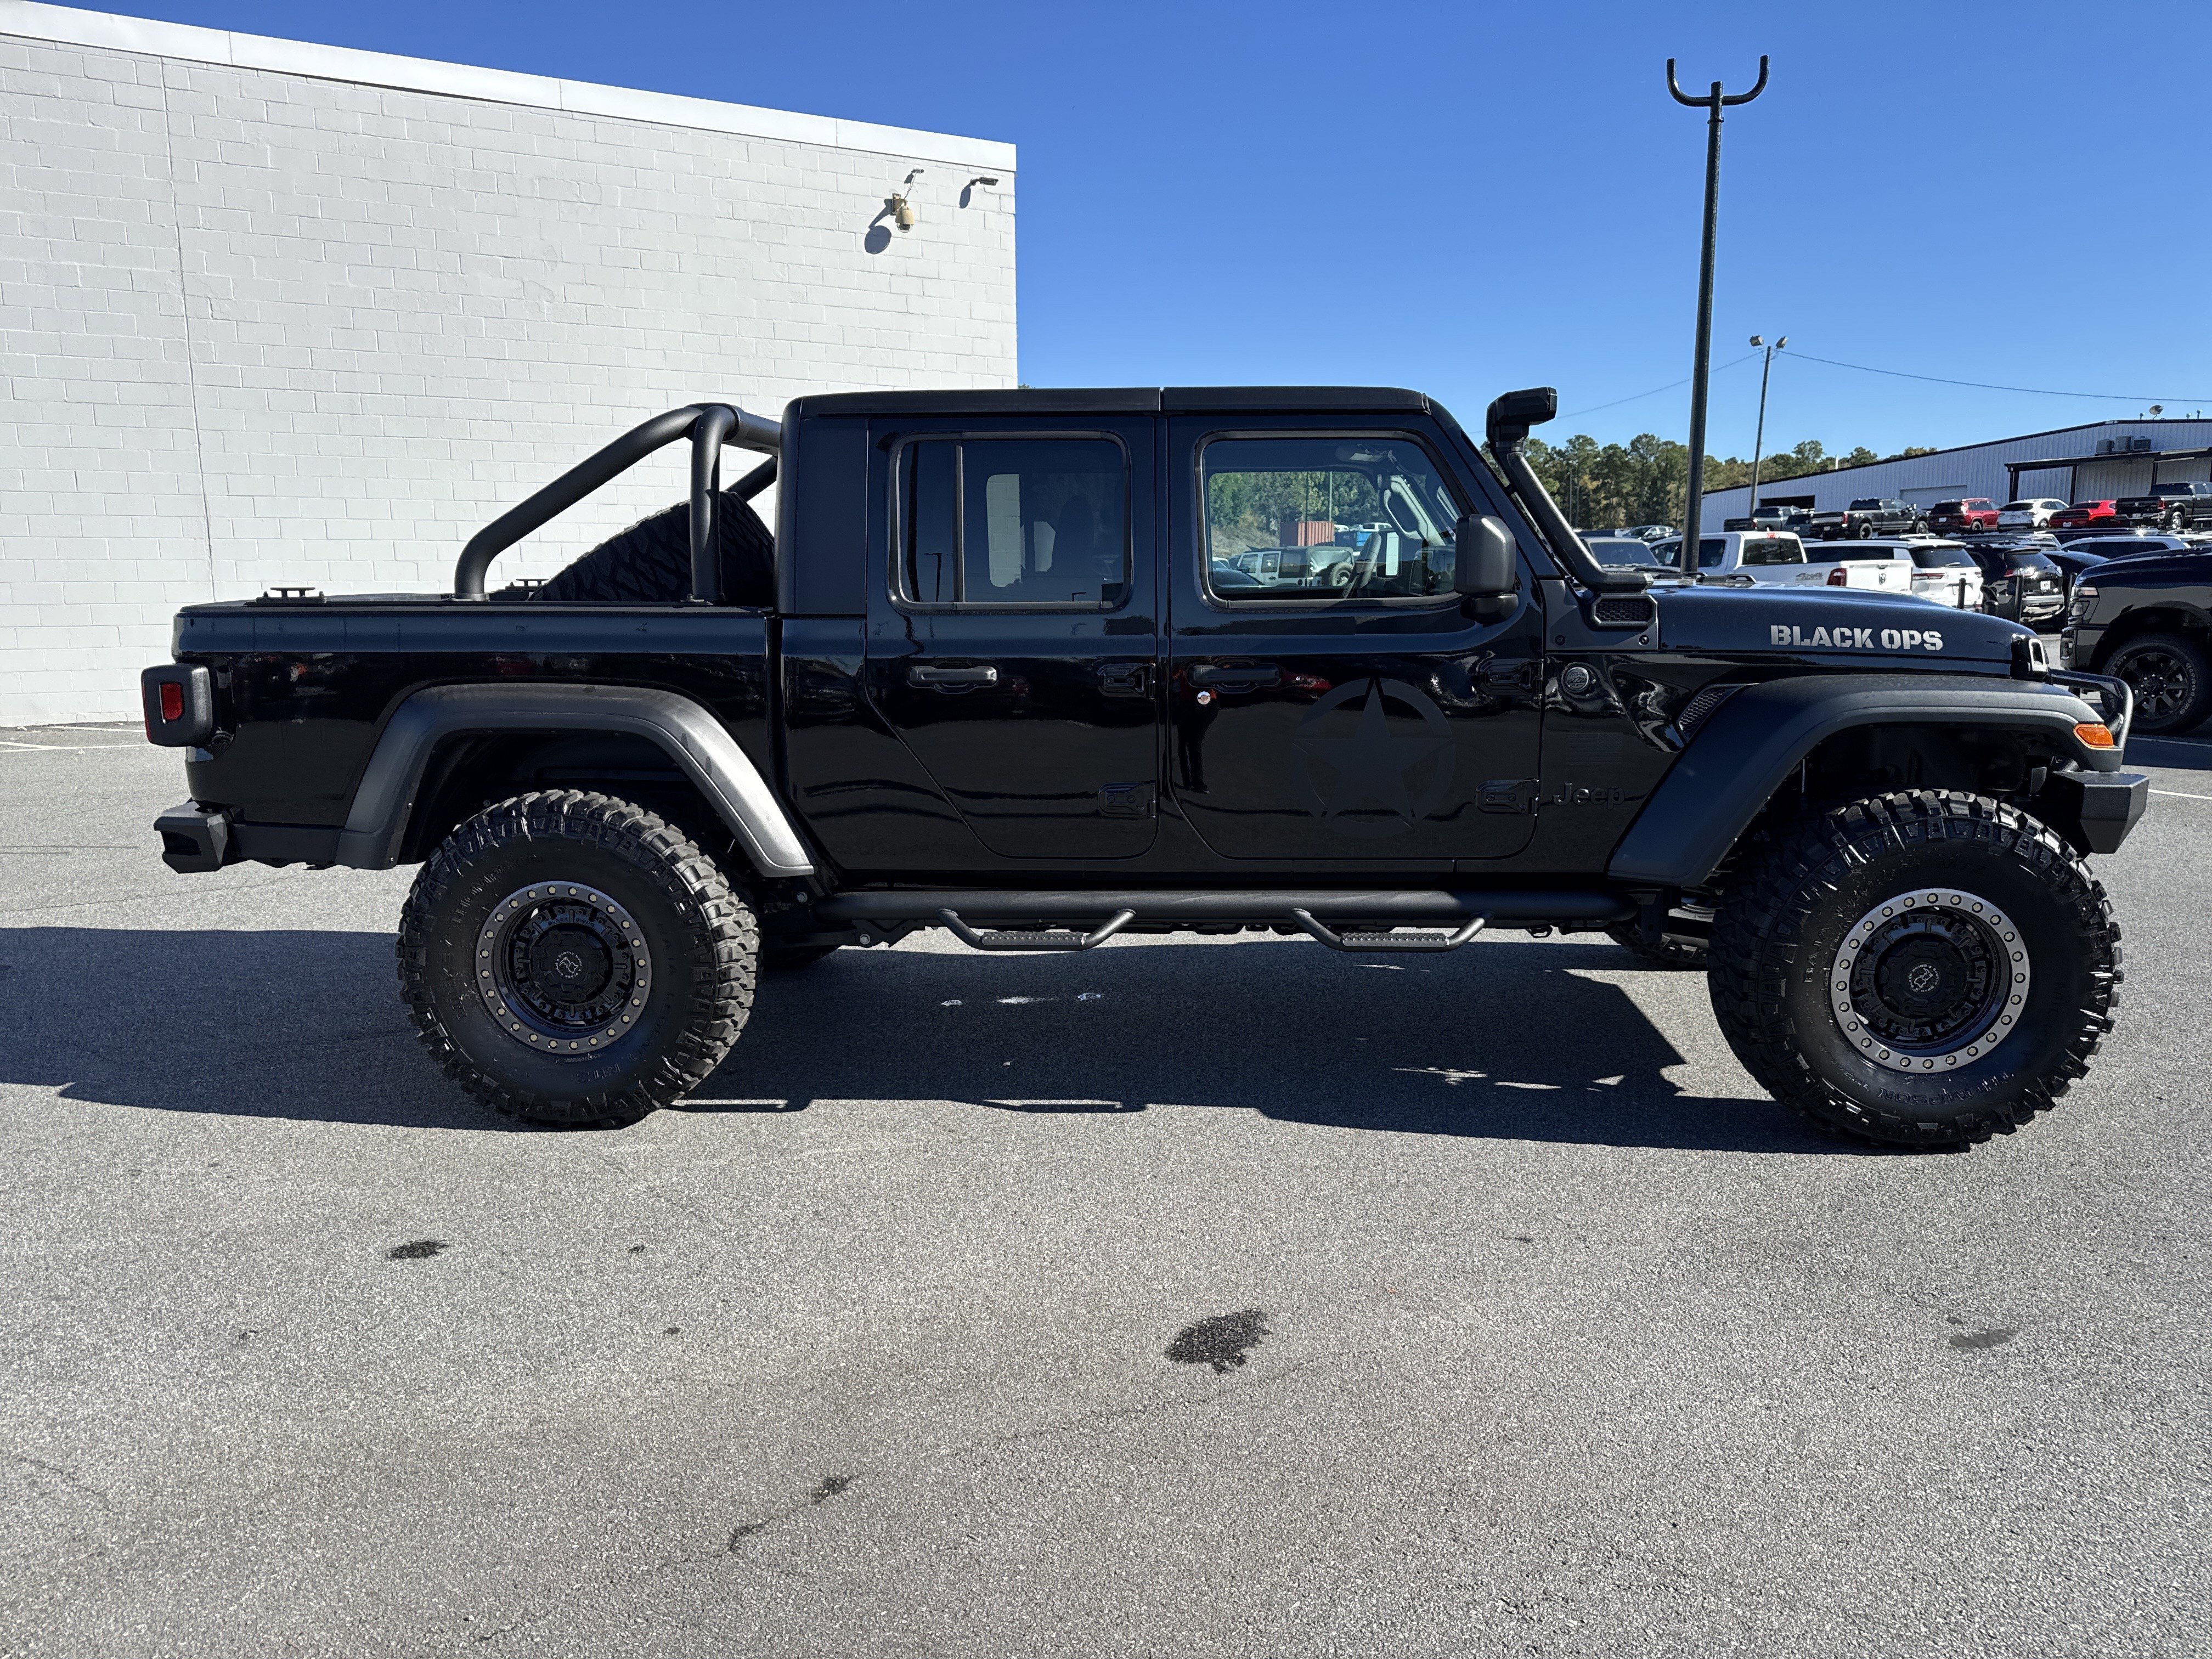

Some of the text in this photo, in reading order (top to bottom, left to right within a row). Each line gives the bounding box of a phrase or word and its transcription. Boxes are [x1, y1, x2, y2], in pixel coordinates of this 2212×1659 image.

[1771, 625, 1943, 651] BLACK OPS
[1553, 783, 1625, 809] Jeep
[1879, 1071, 2015, 1106] THOMPSON
